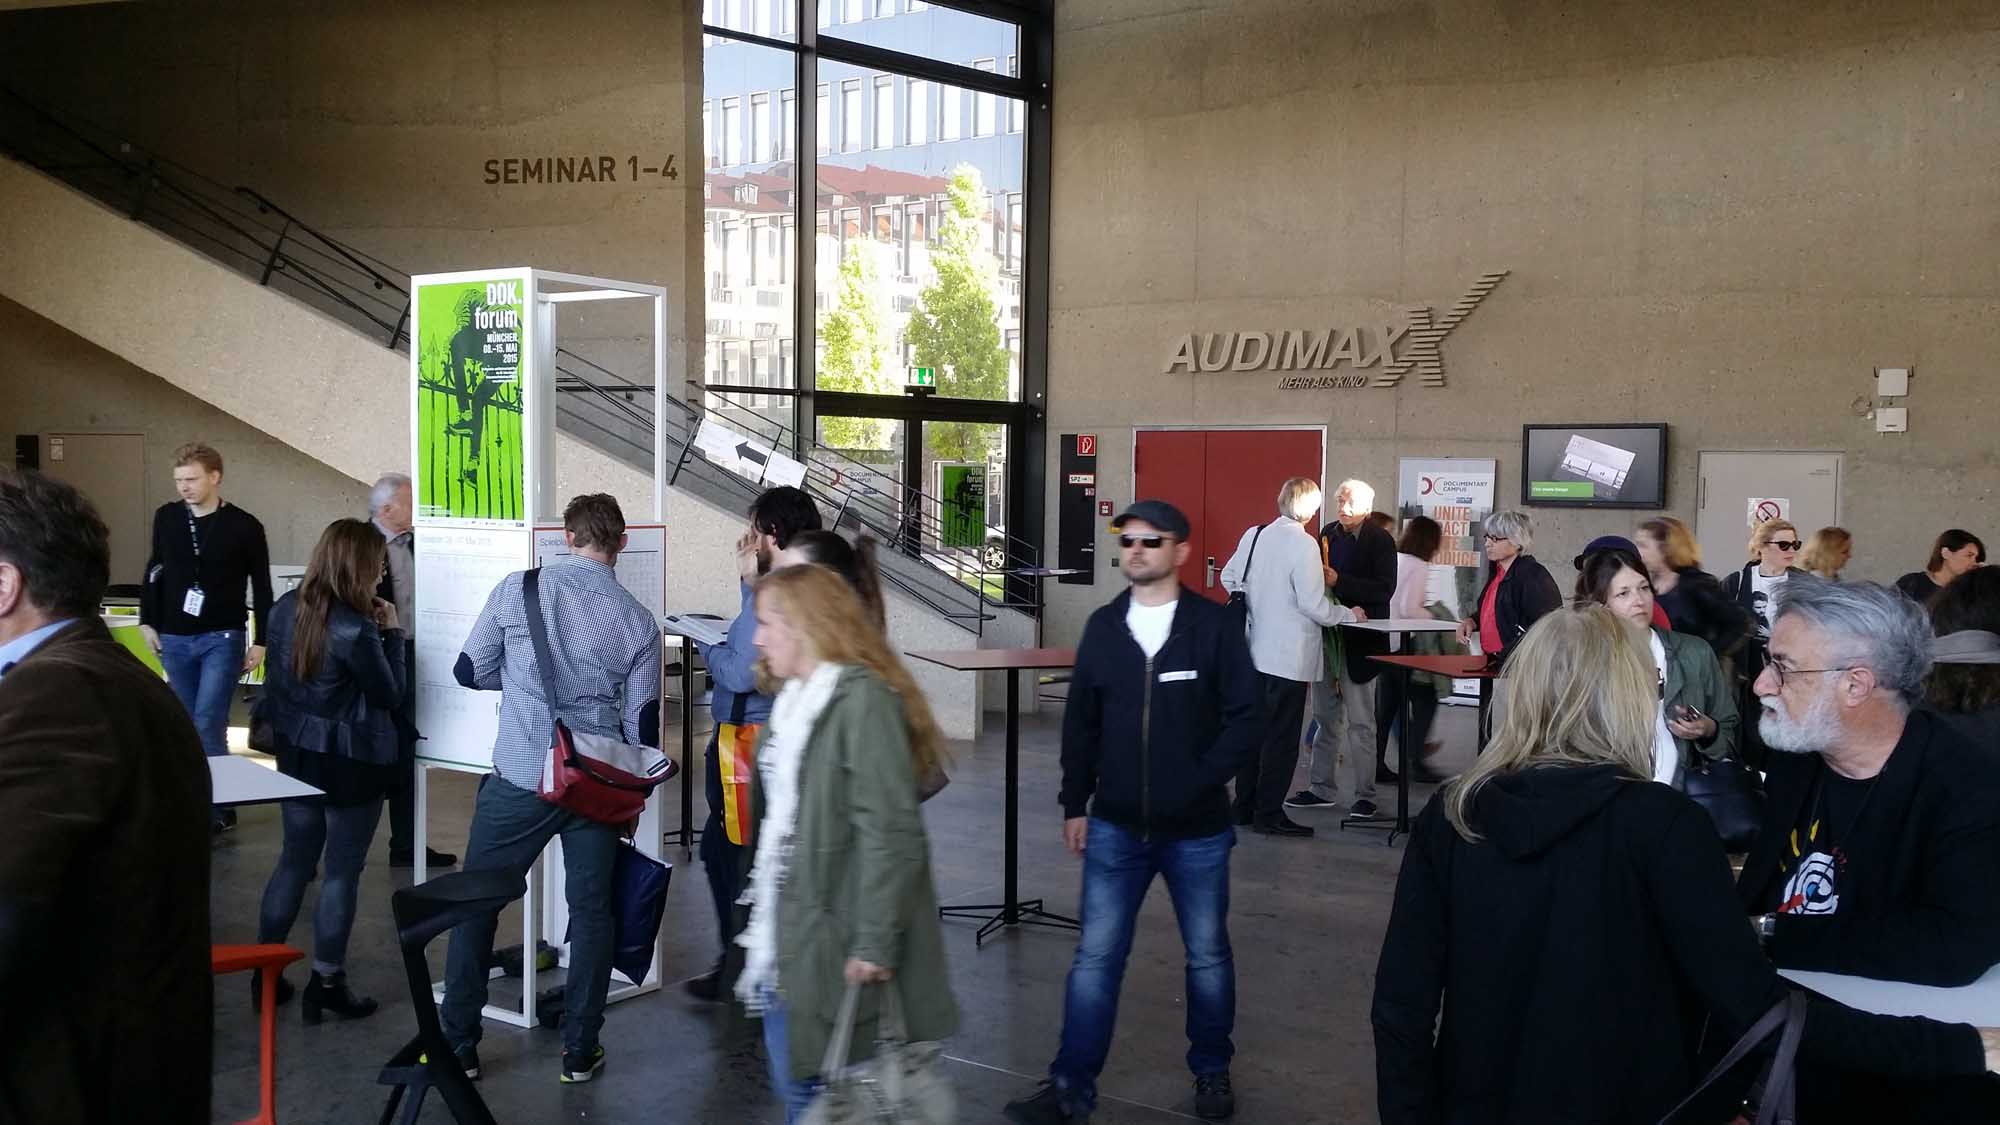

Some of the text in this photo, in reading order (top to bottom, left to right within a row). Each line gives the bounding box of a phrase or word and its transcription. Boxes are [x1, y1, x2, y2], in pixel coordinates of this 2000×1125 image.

[484, 156, 616, 184] SEMINAR
[487, 283, 522, 305] DOK.
[475, 307, 518, 330] forum
[506, 342, 518, 353] MAI
[503, 354, 518, 363] 2015
[1279, 376, 1368, 390] MEHR ALS KINO
[1435, 506, 1470, 520] UNITE
